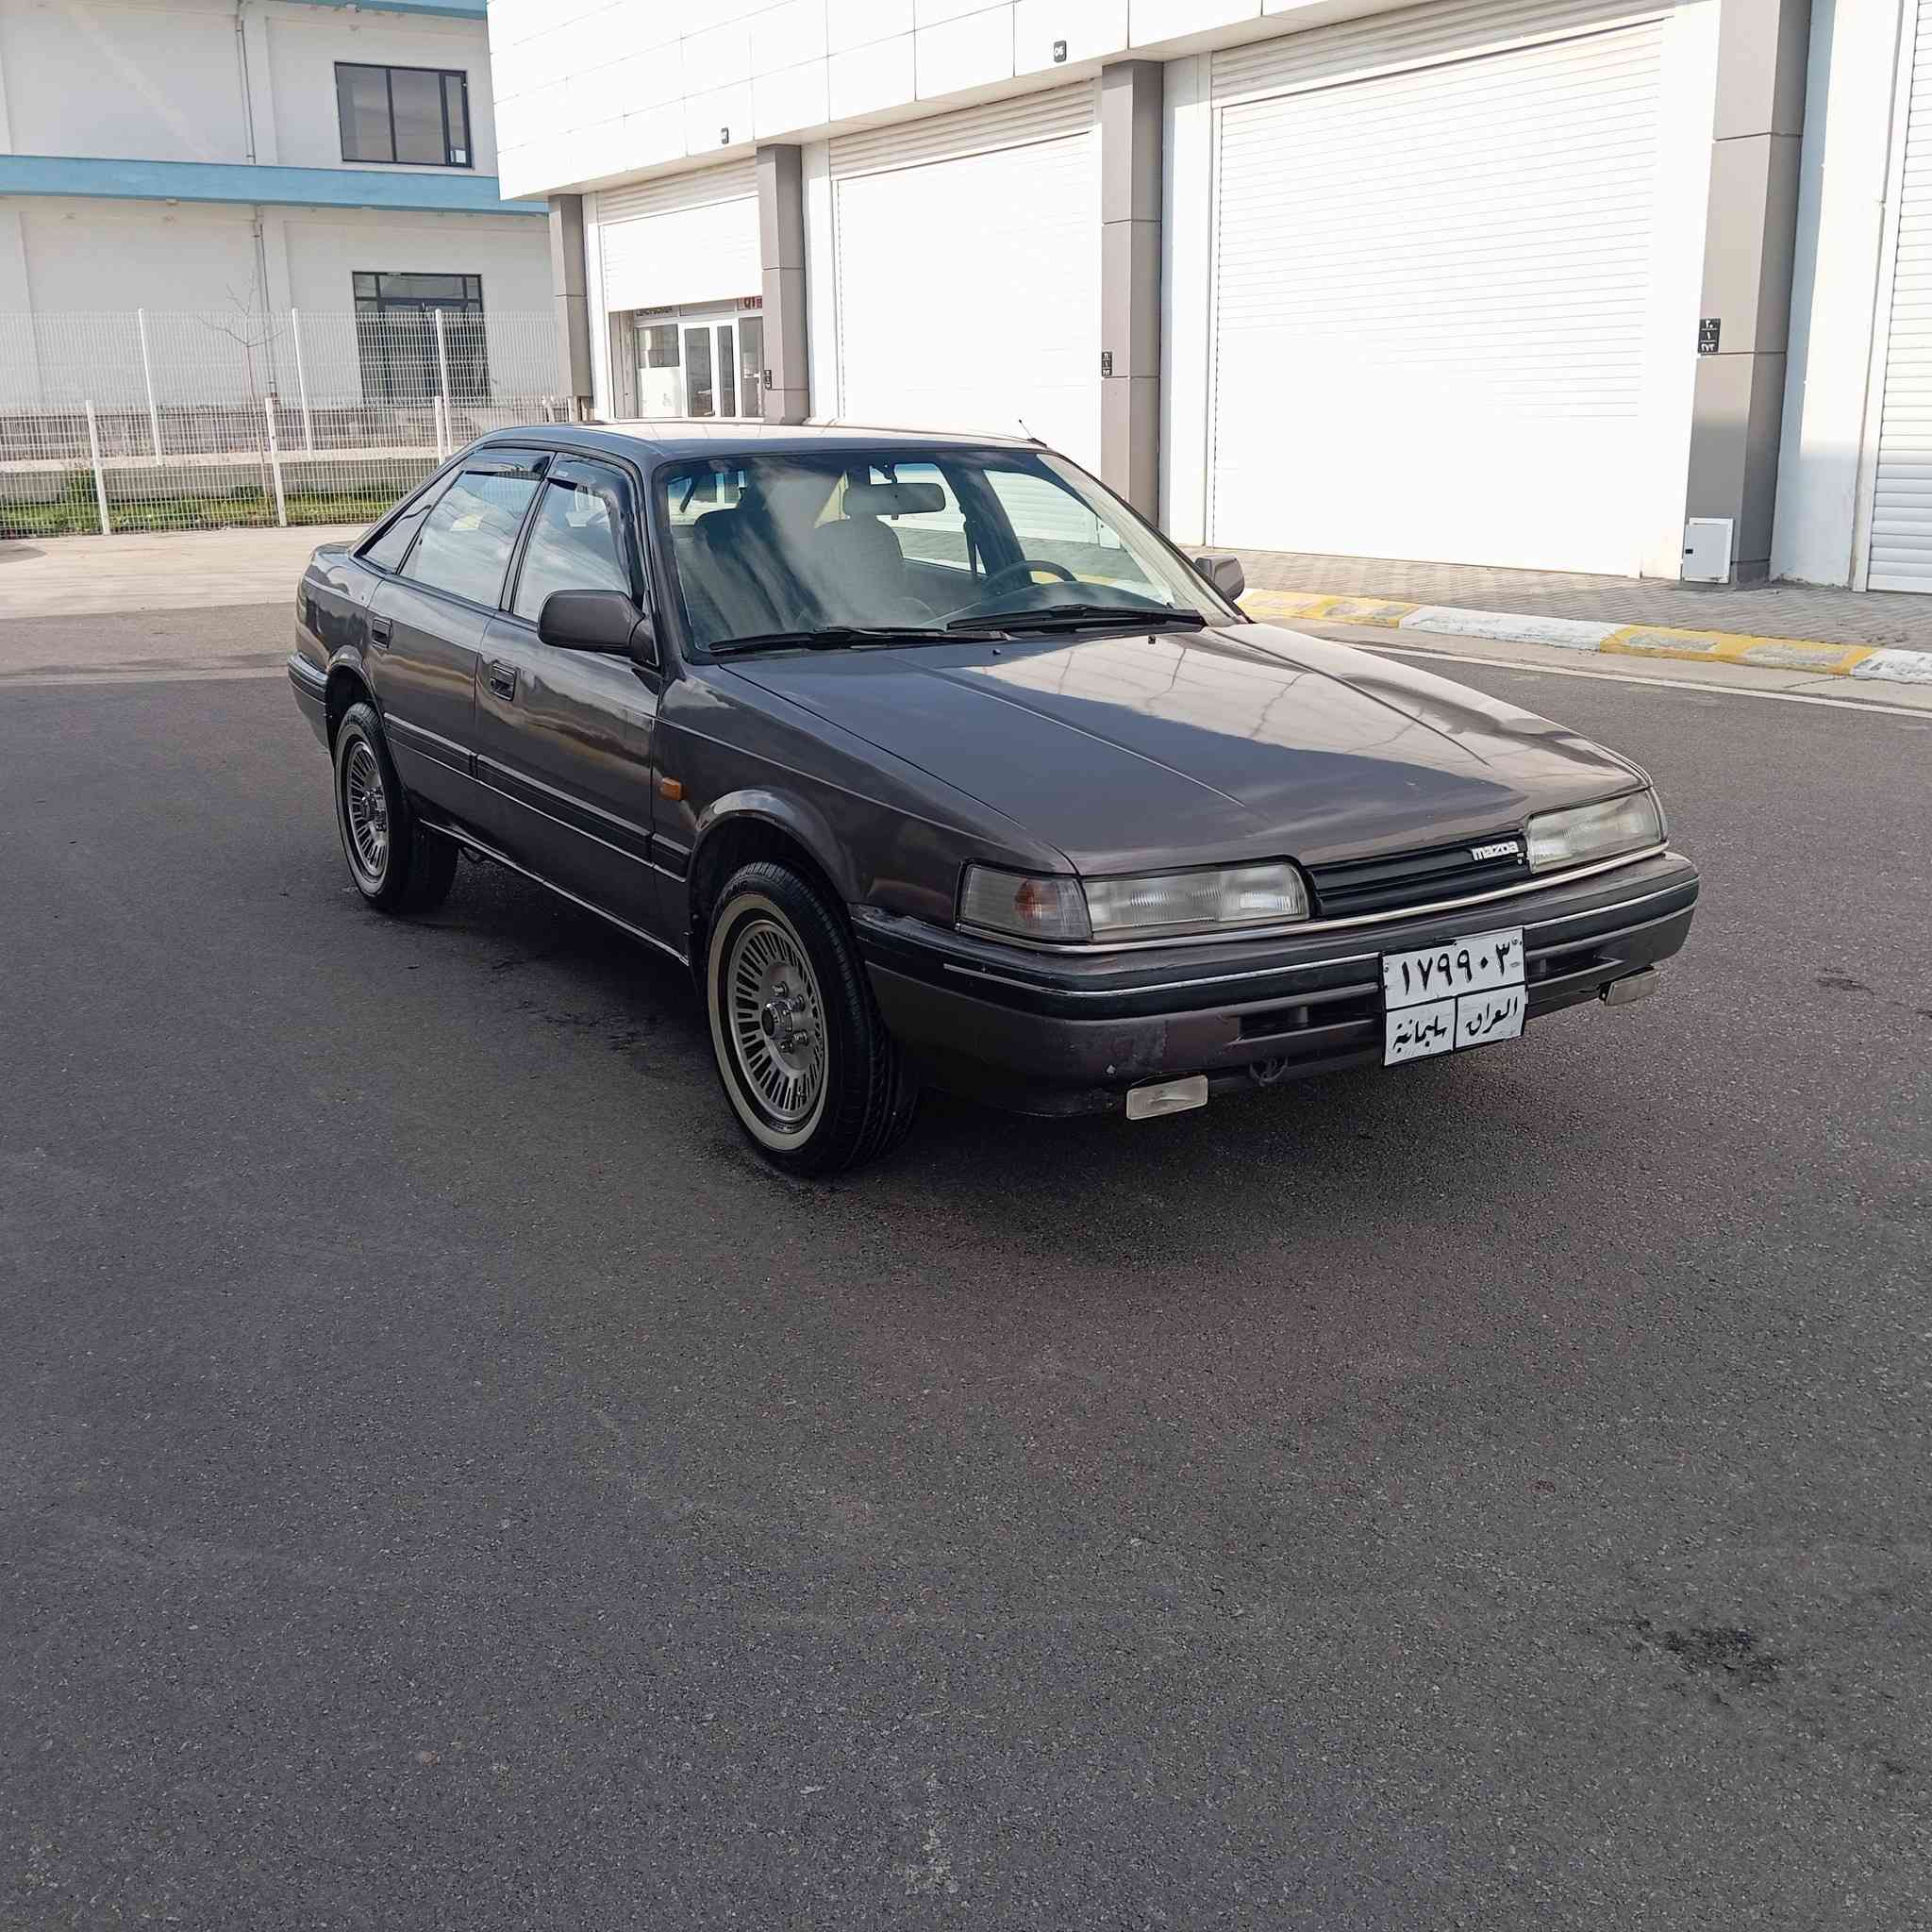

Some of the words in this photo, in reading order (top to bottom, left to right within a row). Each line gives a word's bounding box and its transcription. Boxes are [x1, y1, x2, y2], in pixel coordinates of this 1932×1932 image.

[1472, 841, 1519, 861] mazda
[1401, 941, 1510, 996] ١٧٩٩٠٣
[1465, 996, 1518, 1036] العراق
